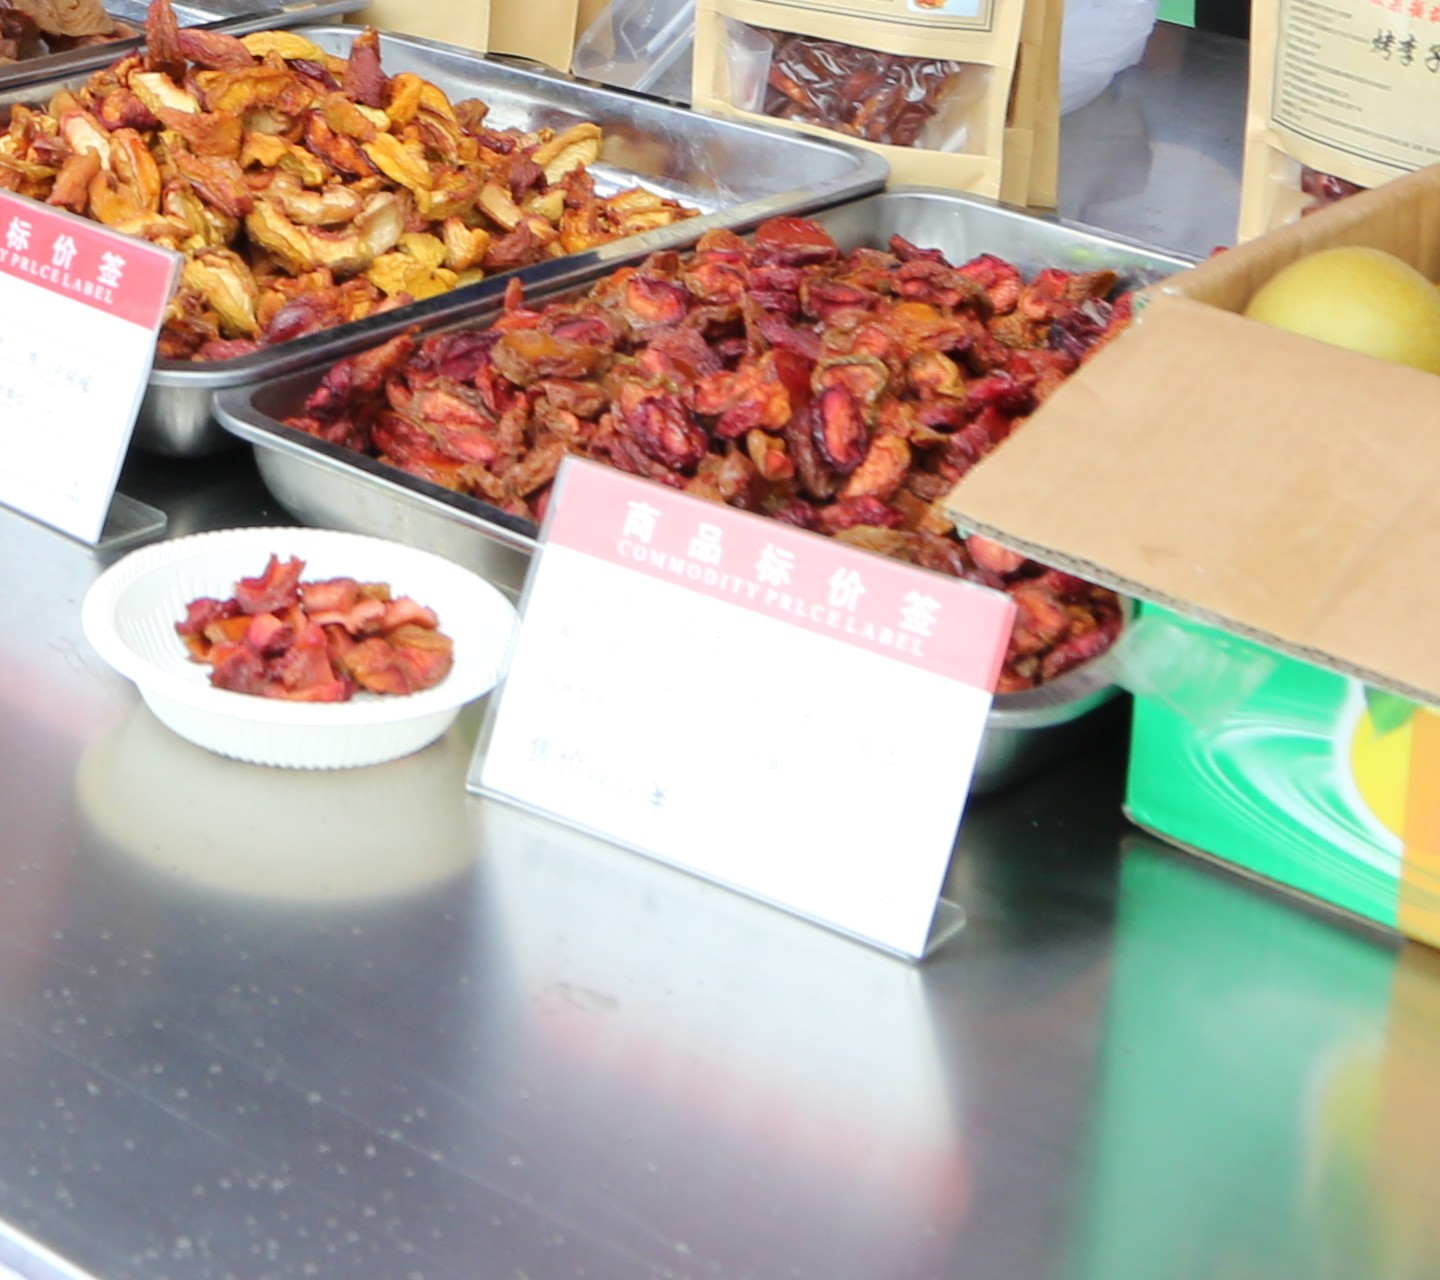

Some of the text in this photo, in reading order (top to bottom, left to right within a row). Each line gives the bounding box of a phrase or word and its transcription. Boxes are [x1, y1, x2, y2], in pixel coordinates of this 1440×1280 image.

[62, 269, 114, 306] LABEL
[617, 540, 763, 603] COMMODITY
[844, 614, 926, 658] LABEL
[623, 501, 942, 639] 商品标价签
